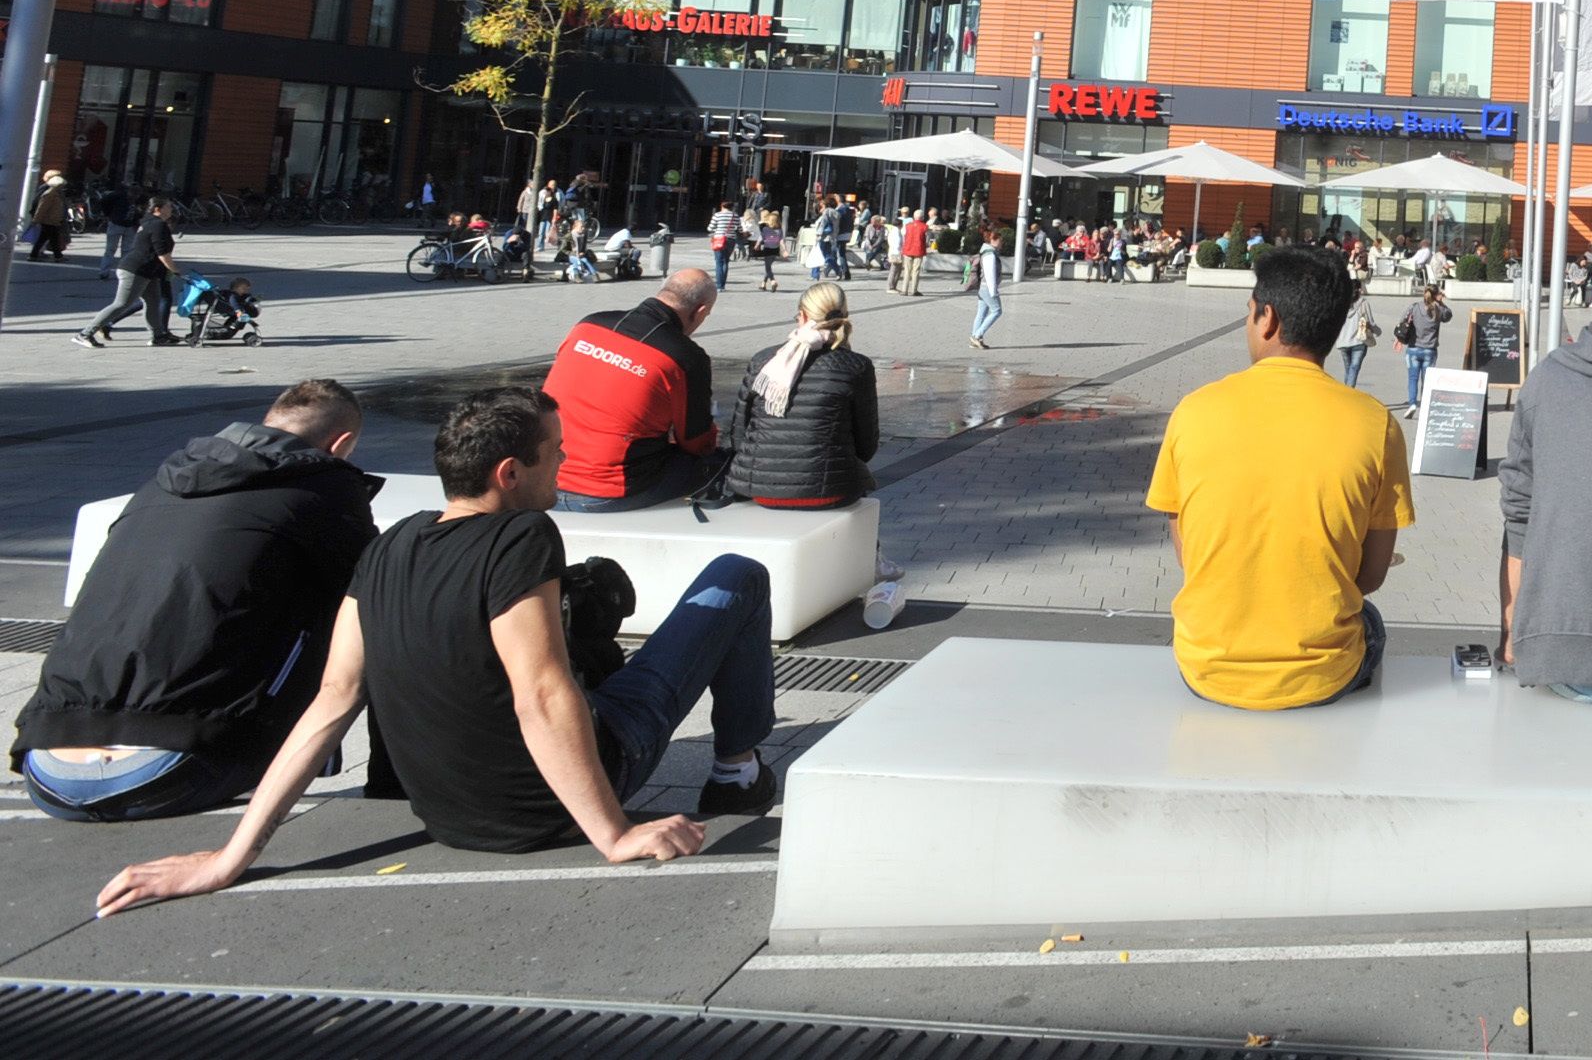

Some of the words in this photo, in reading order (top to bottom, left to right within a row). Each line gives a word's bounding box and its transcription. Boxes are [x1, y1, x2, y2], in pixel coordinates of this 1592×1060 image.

[1049, 83, 1161, 119] REWE
[1279, 104, 1395, 131] Deutsche
[1402, 110, 1465, 134] Bank
